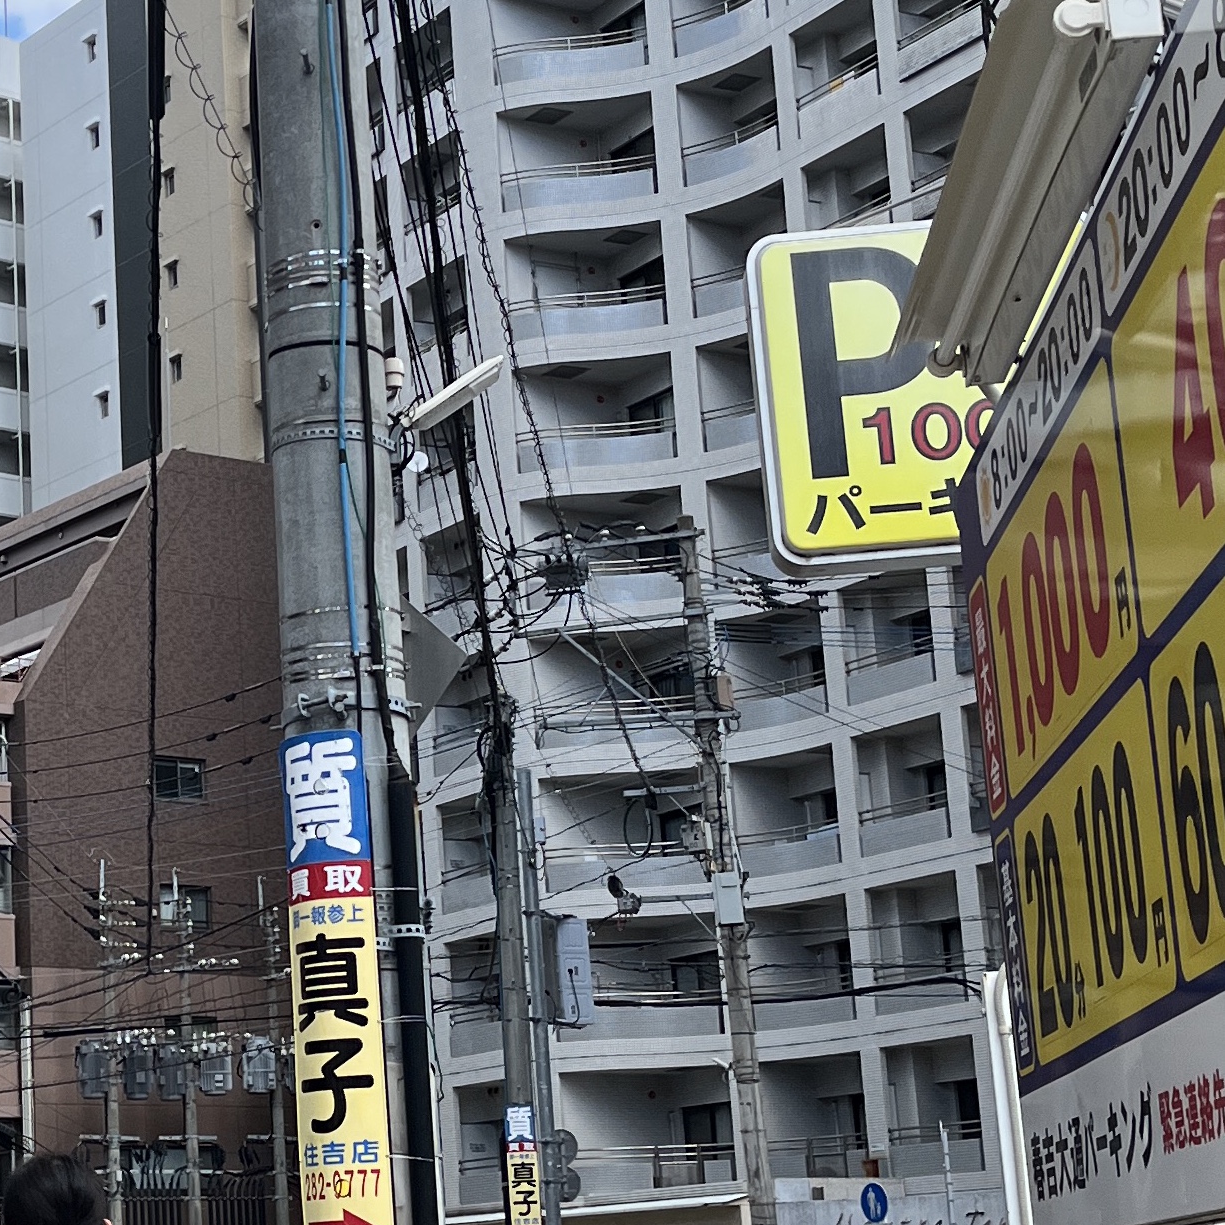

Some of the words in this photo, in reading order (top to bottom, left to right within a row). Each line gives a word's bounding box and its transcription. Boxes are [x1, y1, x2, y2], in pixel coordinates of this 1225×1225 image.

[790, 247, 934, 479] P
[284, 737, 361, 863] 質
[291, 864, 364, 900] 買取
[1001, 859, 1030, 1057] 基本料金
[296, 933, 374, 1134] 真子
[303, 1139, 379, 1167] 住吉店
[506, 1106, 533, 1141] 質
[1031, 1081, 1152, 1202] 春吉大通パーキング
[1158, 1068, 1225, 1155] 緊急連絡先
[305, 1168, 381, 1201] 282-0777
[511, 1161, 537, 1217] 真子
